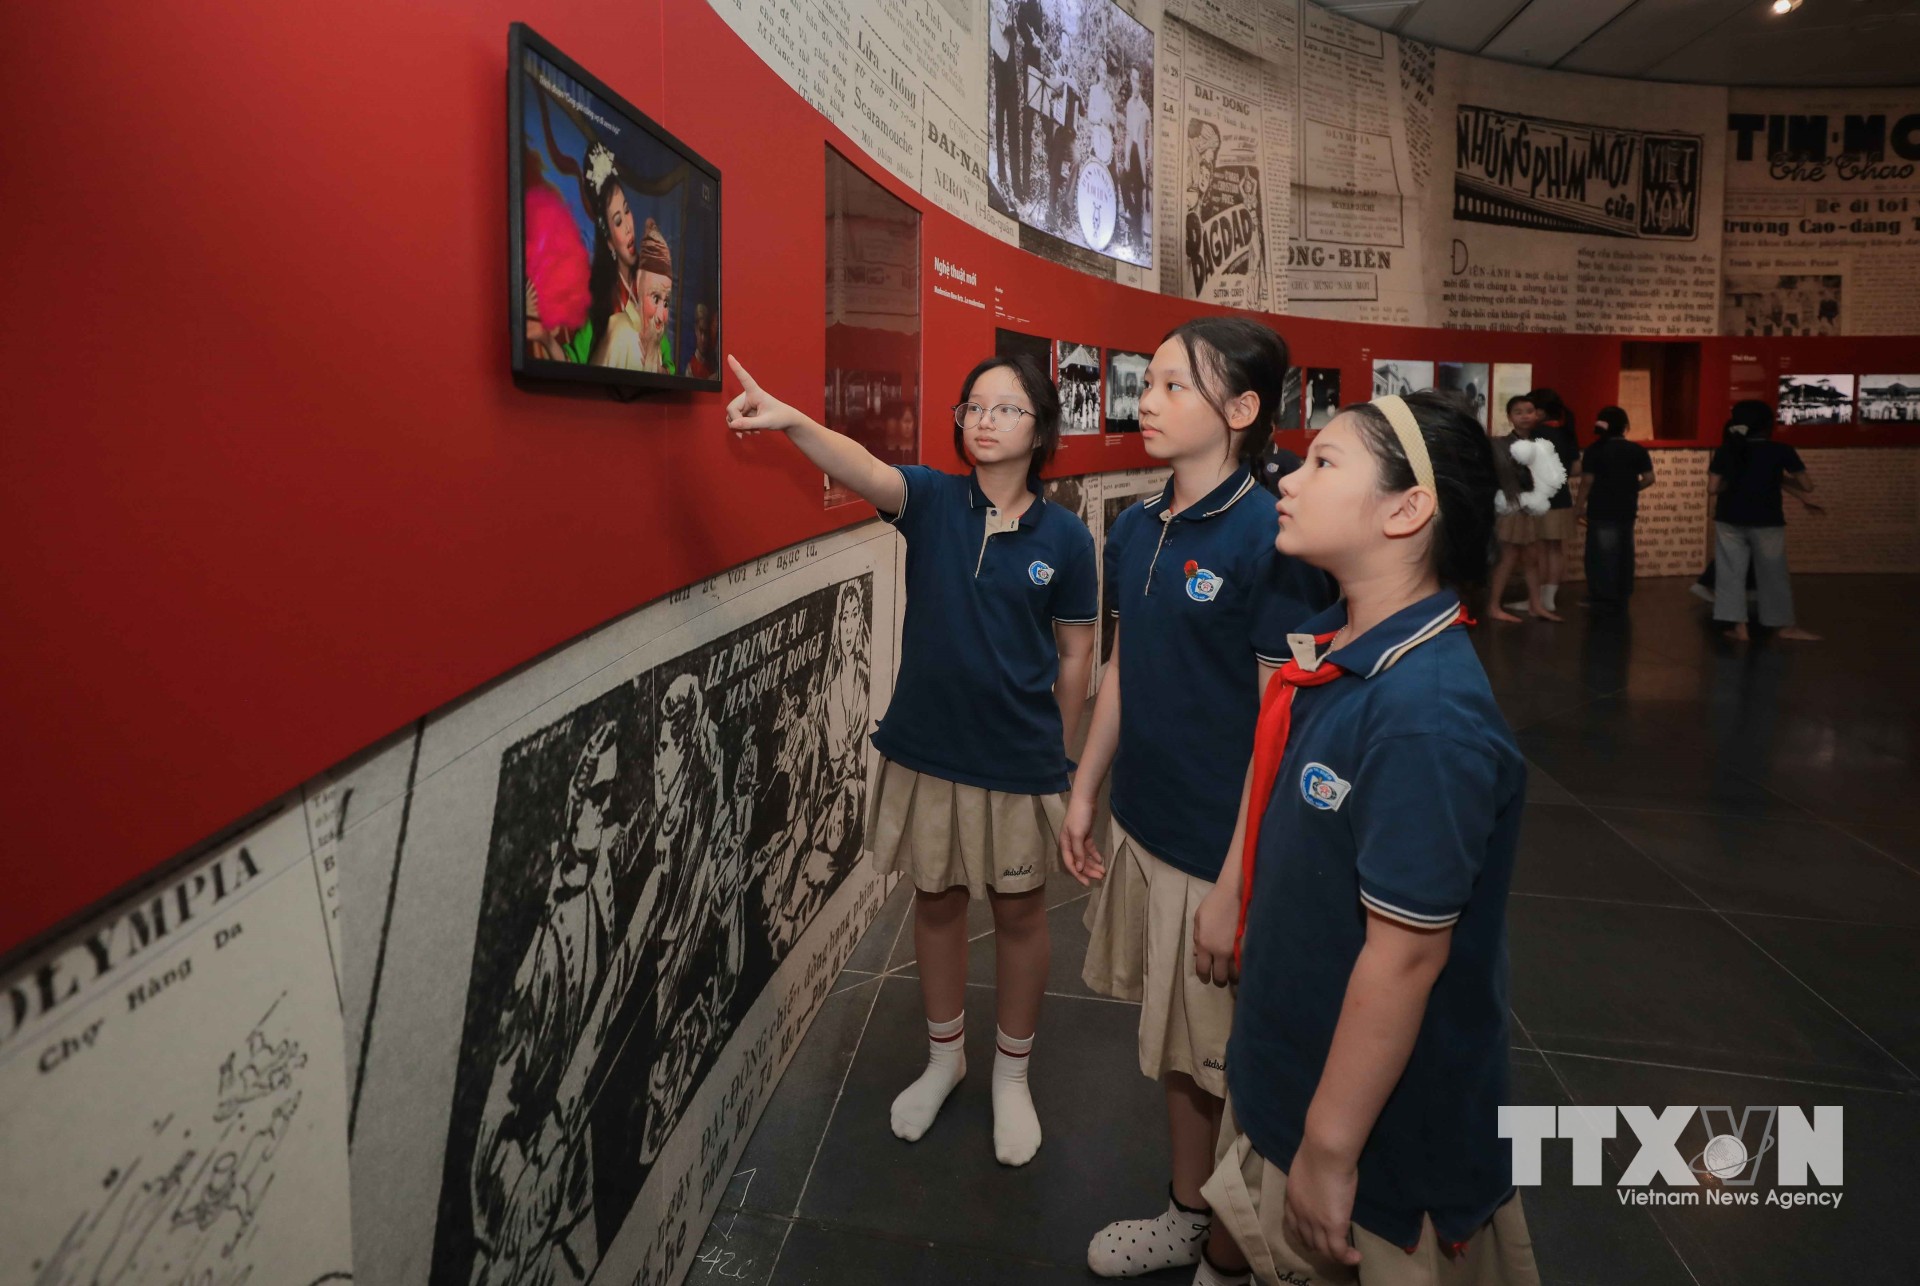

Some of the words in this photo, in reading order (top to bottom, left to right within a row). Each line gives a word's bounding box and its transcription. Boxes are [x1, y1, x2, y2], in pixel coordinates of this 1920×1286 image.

[915, 9, 936, 41] Town
[854, 86, 913, 156] Scaramouche
[1457, 110, 1531, 187] NHỮNG
[1530, 136, 1587, 203] PHIM
[1587, 130, 1636, 189] MỚI
[934, 167, 969, 206] NERON
[934, 256, 950, 279] Nghệ
[1186, 208, 1253, 299] BAGDAD
[705, 649, 728, 691] LE
[727, 618, 787, 679] PRINCE
[785, 608, 807, 644] AU
[719, 655, 784, 724] MASQUE
[783, 631, 825, 680] ROUGE
[127, 958, 192, 1012] Hàng
[213, 922, 243, 951] Da
